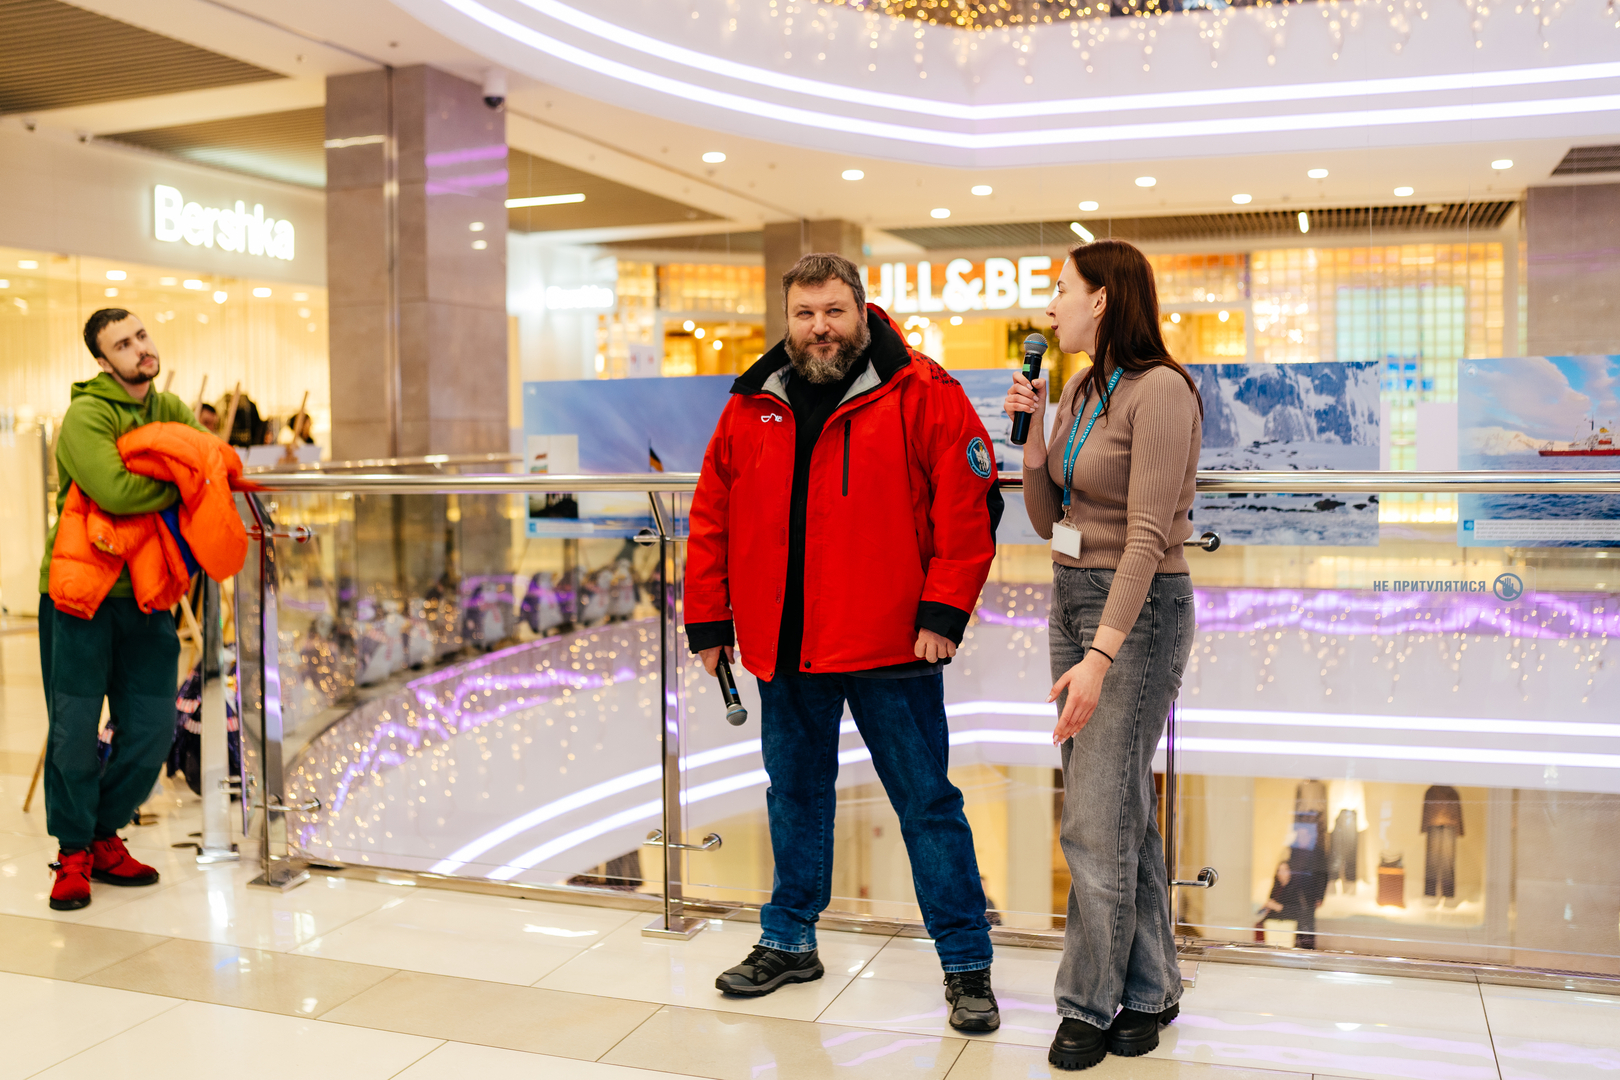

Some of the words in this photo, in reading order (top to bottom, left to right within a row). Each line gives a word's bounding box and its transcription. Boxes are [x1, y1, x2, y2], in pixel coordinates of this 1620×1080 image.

[154, 184, 295, 261] Bershka
[860, 256, 1068, 314] ULL&BE
[1373, 580, 1389, 592] НЕ
[1393, 580, 1486, 593] ПРИТУЛЯТИСЯ
